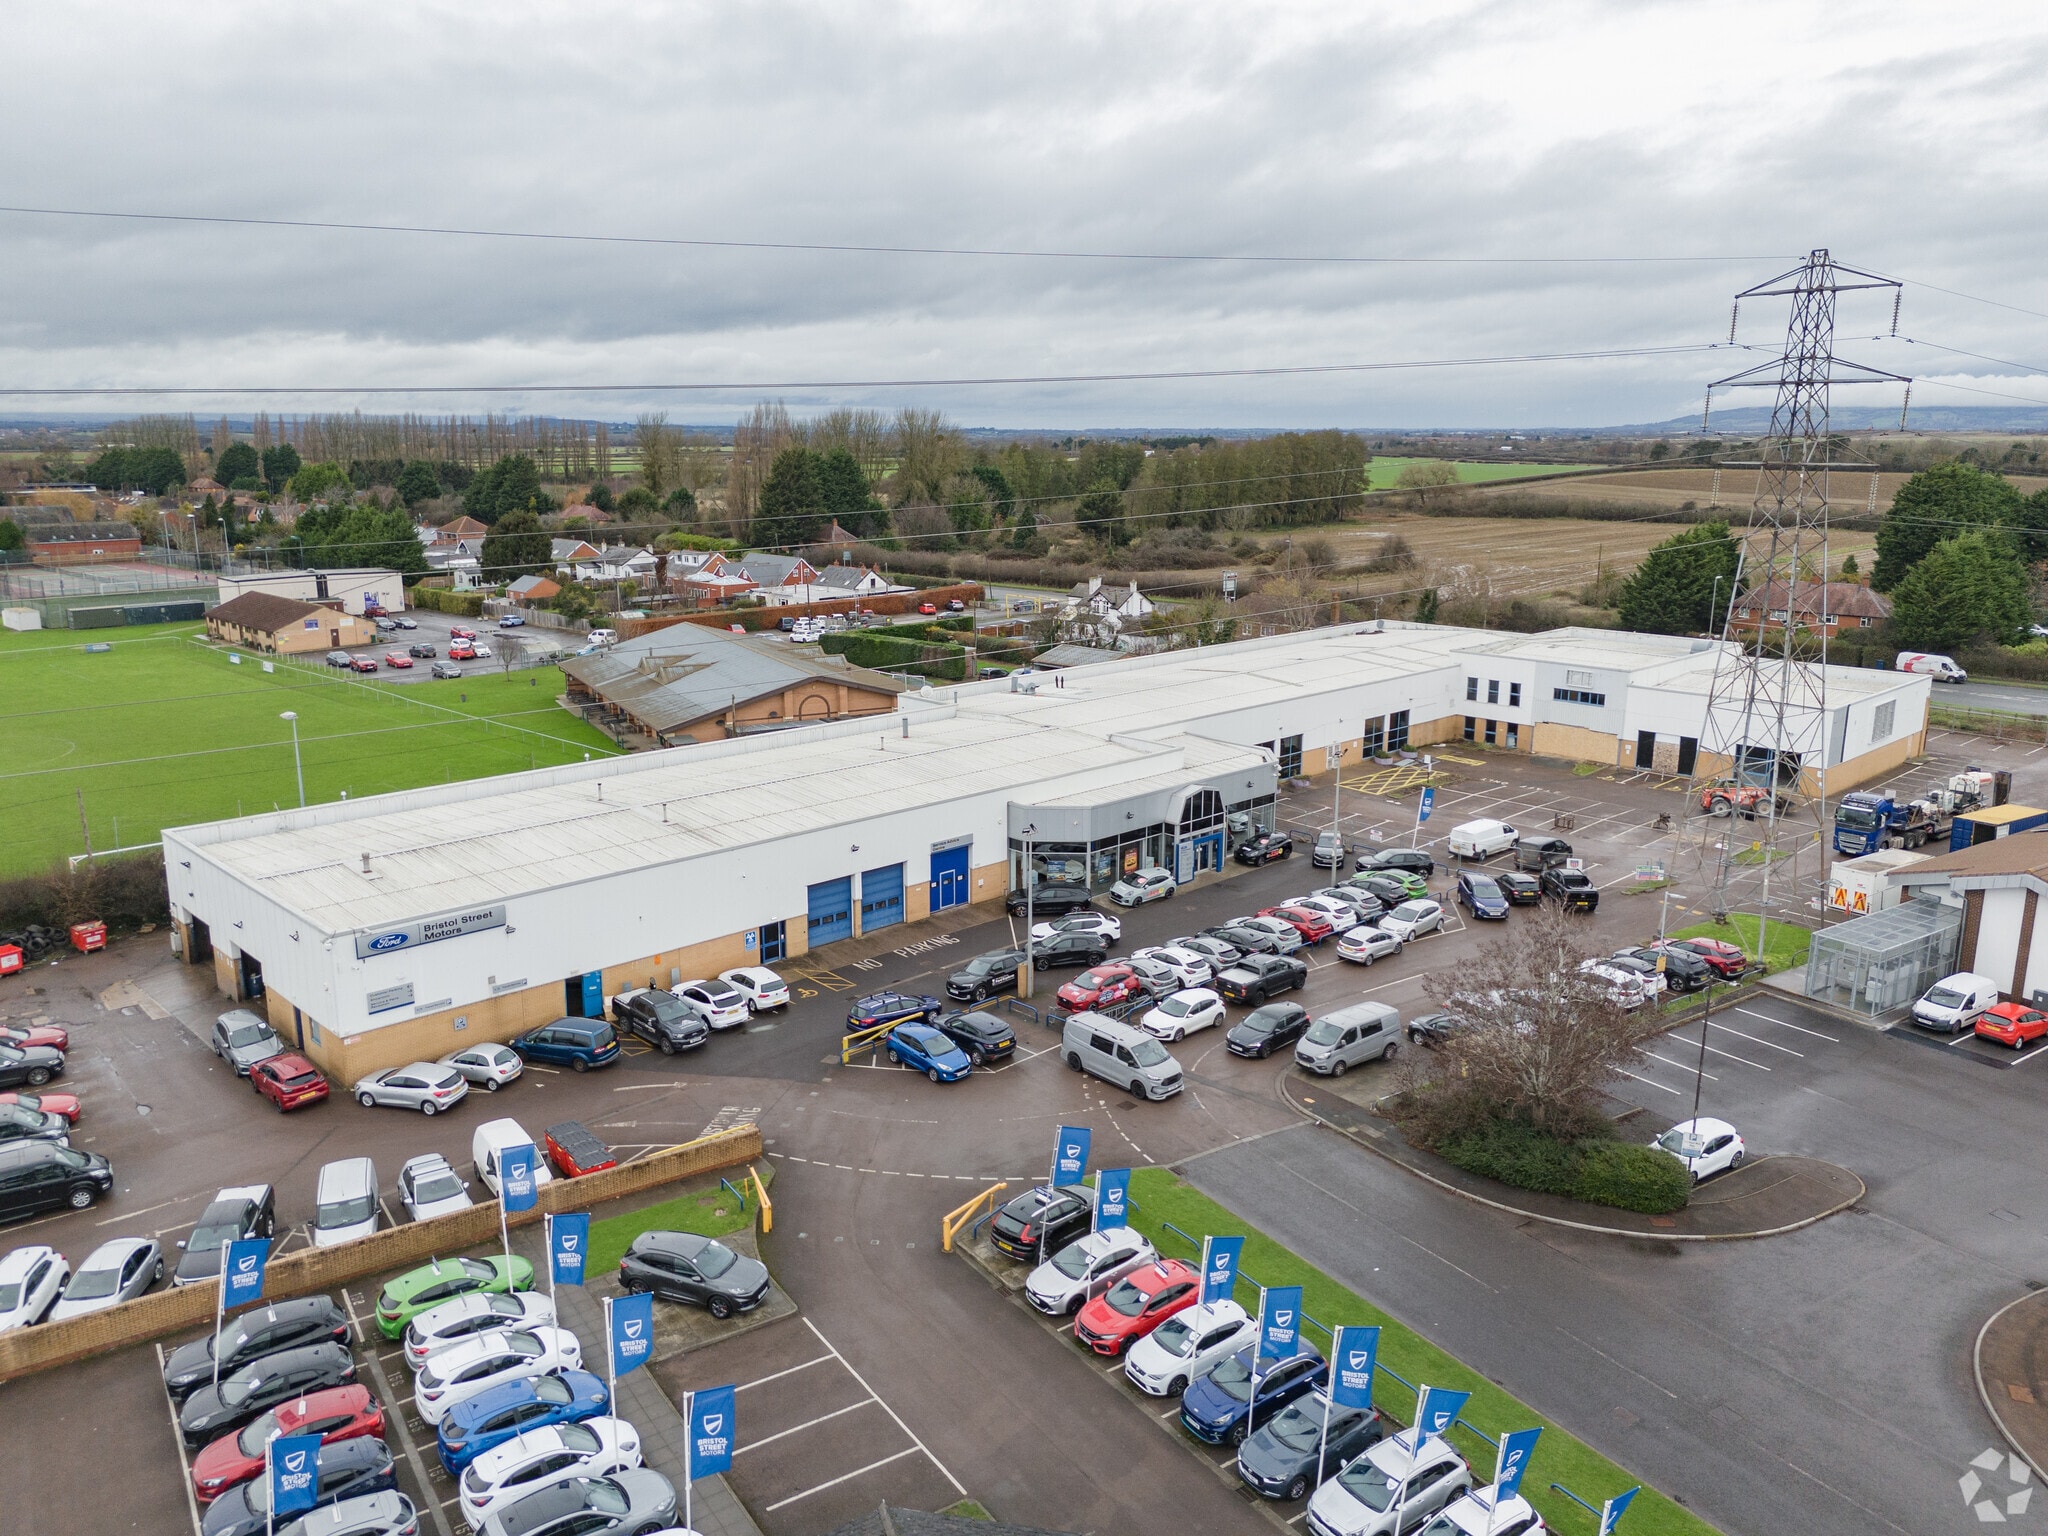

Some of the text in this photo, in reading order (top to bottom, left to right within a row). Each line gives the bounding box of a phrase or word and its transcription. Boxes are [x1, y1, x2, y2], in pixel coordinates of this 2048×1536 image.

[424, 911, 493, 932] Bristol Street
[424, 926, 462, 941] Motors
[377, 936, 402, 948] Ford
[852, 934, 960, 972] NO PARKING
[232, 1271, 259, 1281] BRISTOL
[620, 1339, 648, 1347] BRISTOL
[1342, 1370, 1369, 1379] BRISTOL
[281, 1472, 312, 1482] BRISTOL
[283, 1477, 310, 1486] STREET
